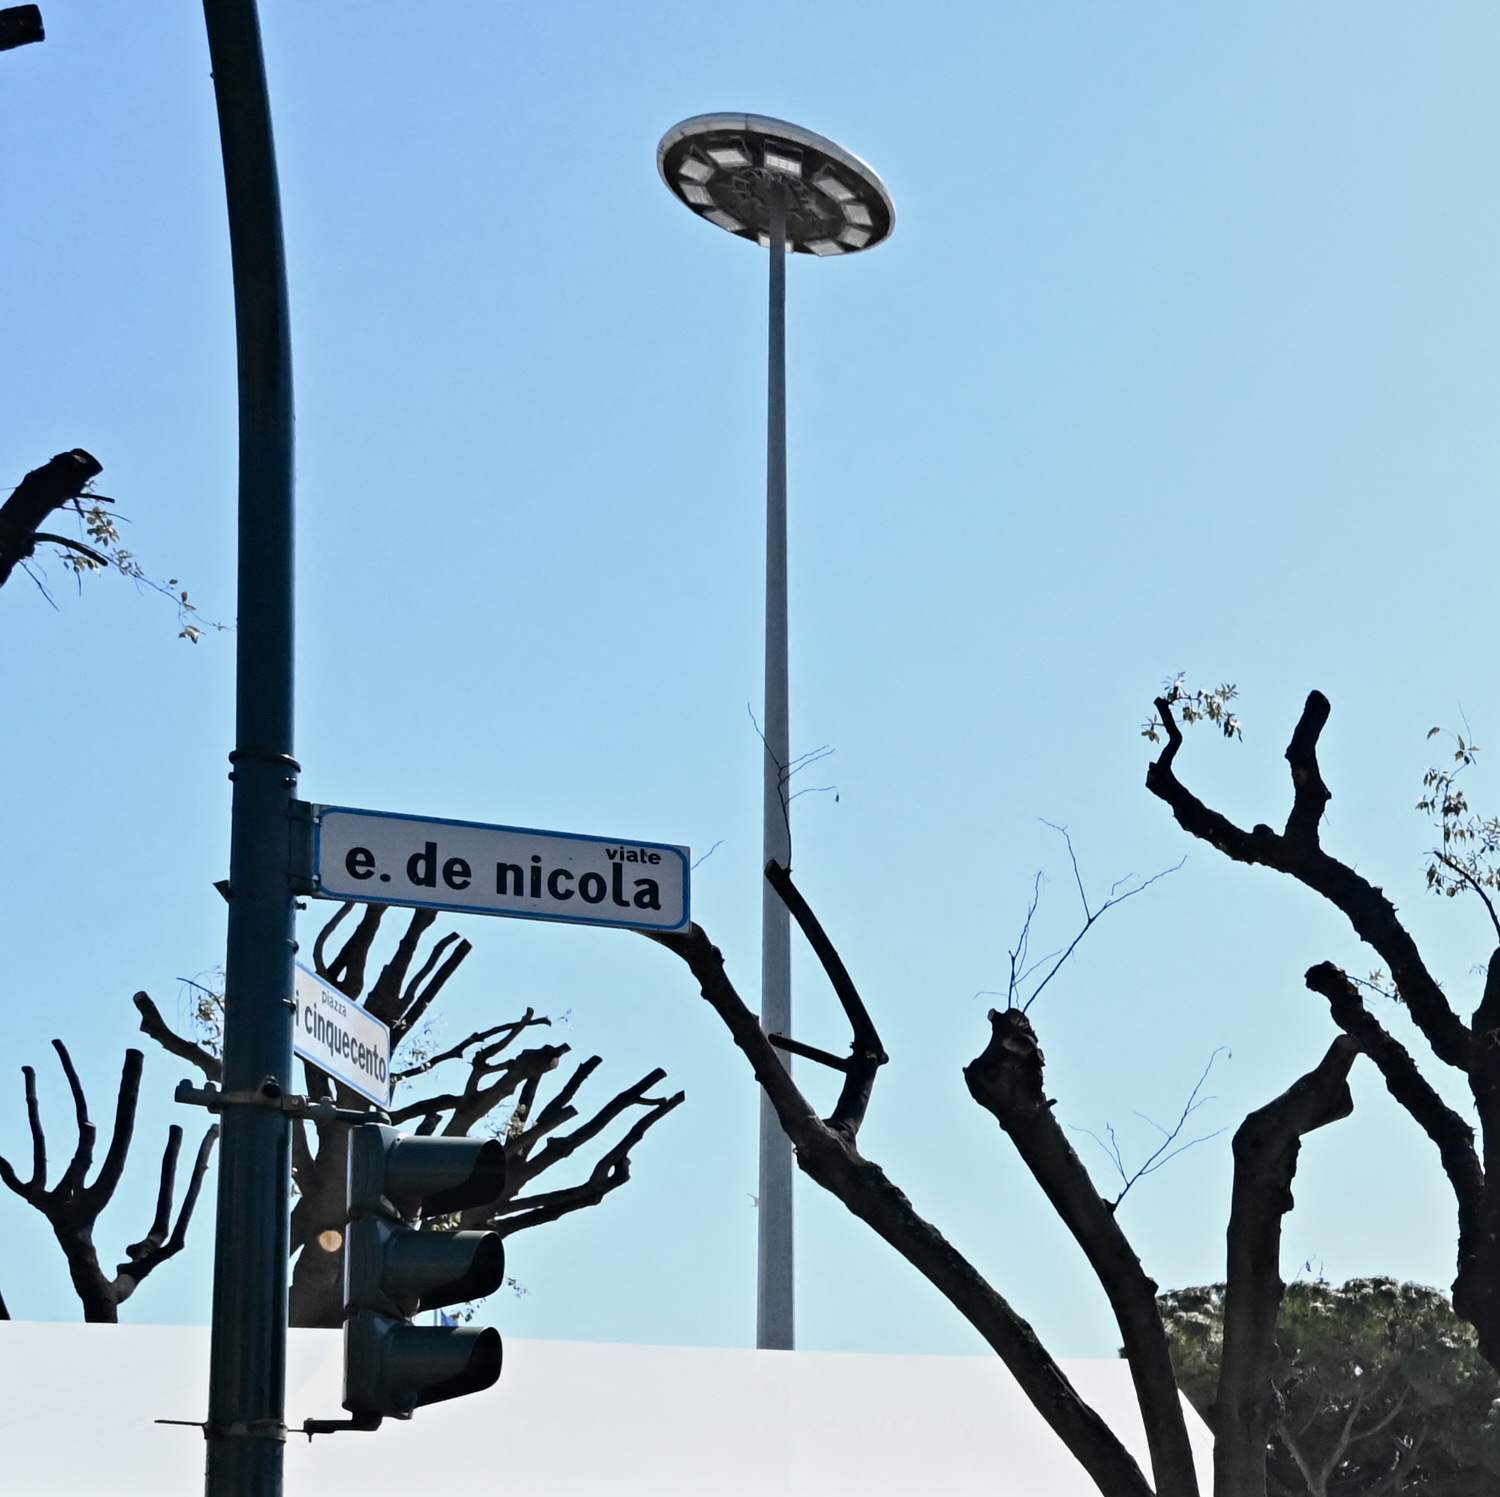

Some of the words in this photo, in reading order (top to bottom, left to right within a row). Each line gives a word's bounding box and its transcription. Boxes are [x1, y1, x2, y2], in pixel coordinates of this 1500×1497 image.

[345, 847, 391, 880] e.
[406, 841, 472, 890] de
[496, 854, 662, 911] nicola
[321, 990, 347, 1017] piazza
[304, 1003, 387, 1083] cinquecento
